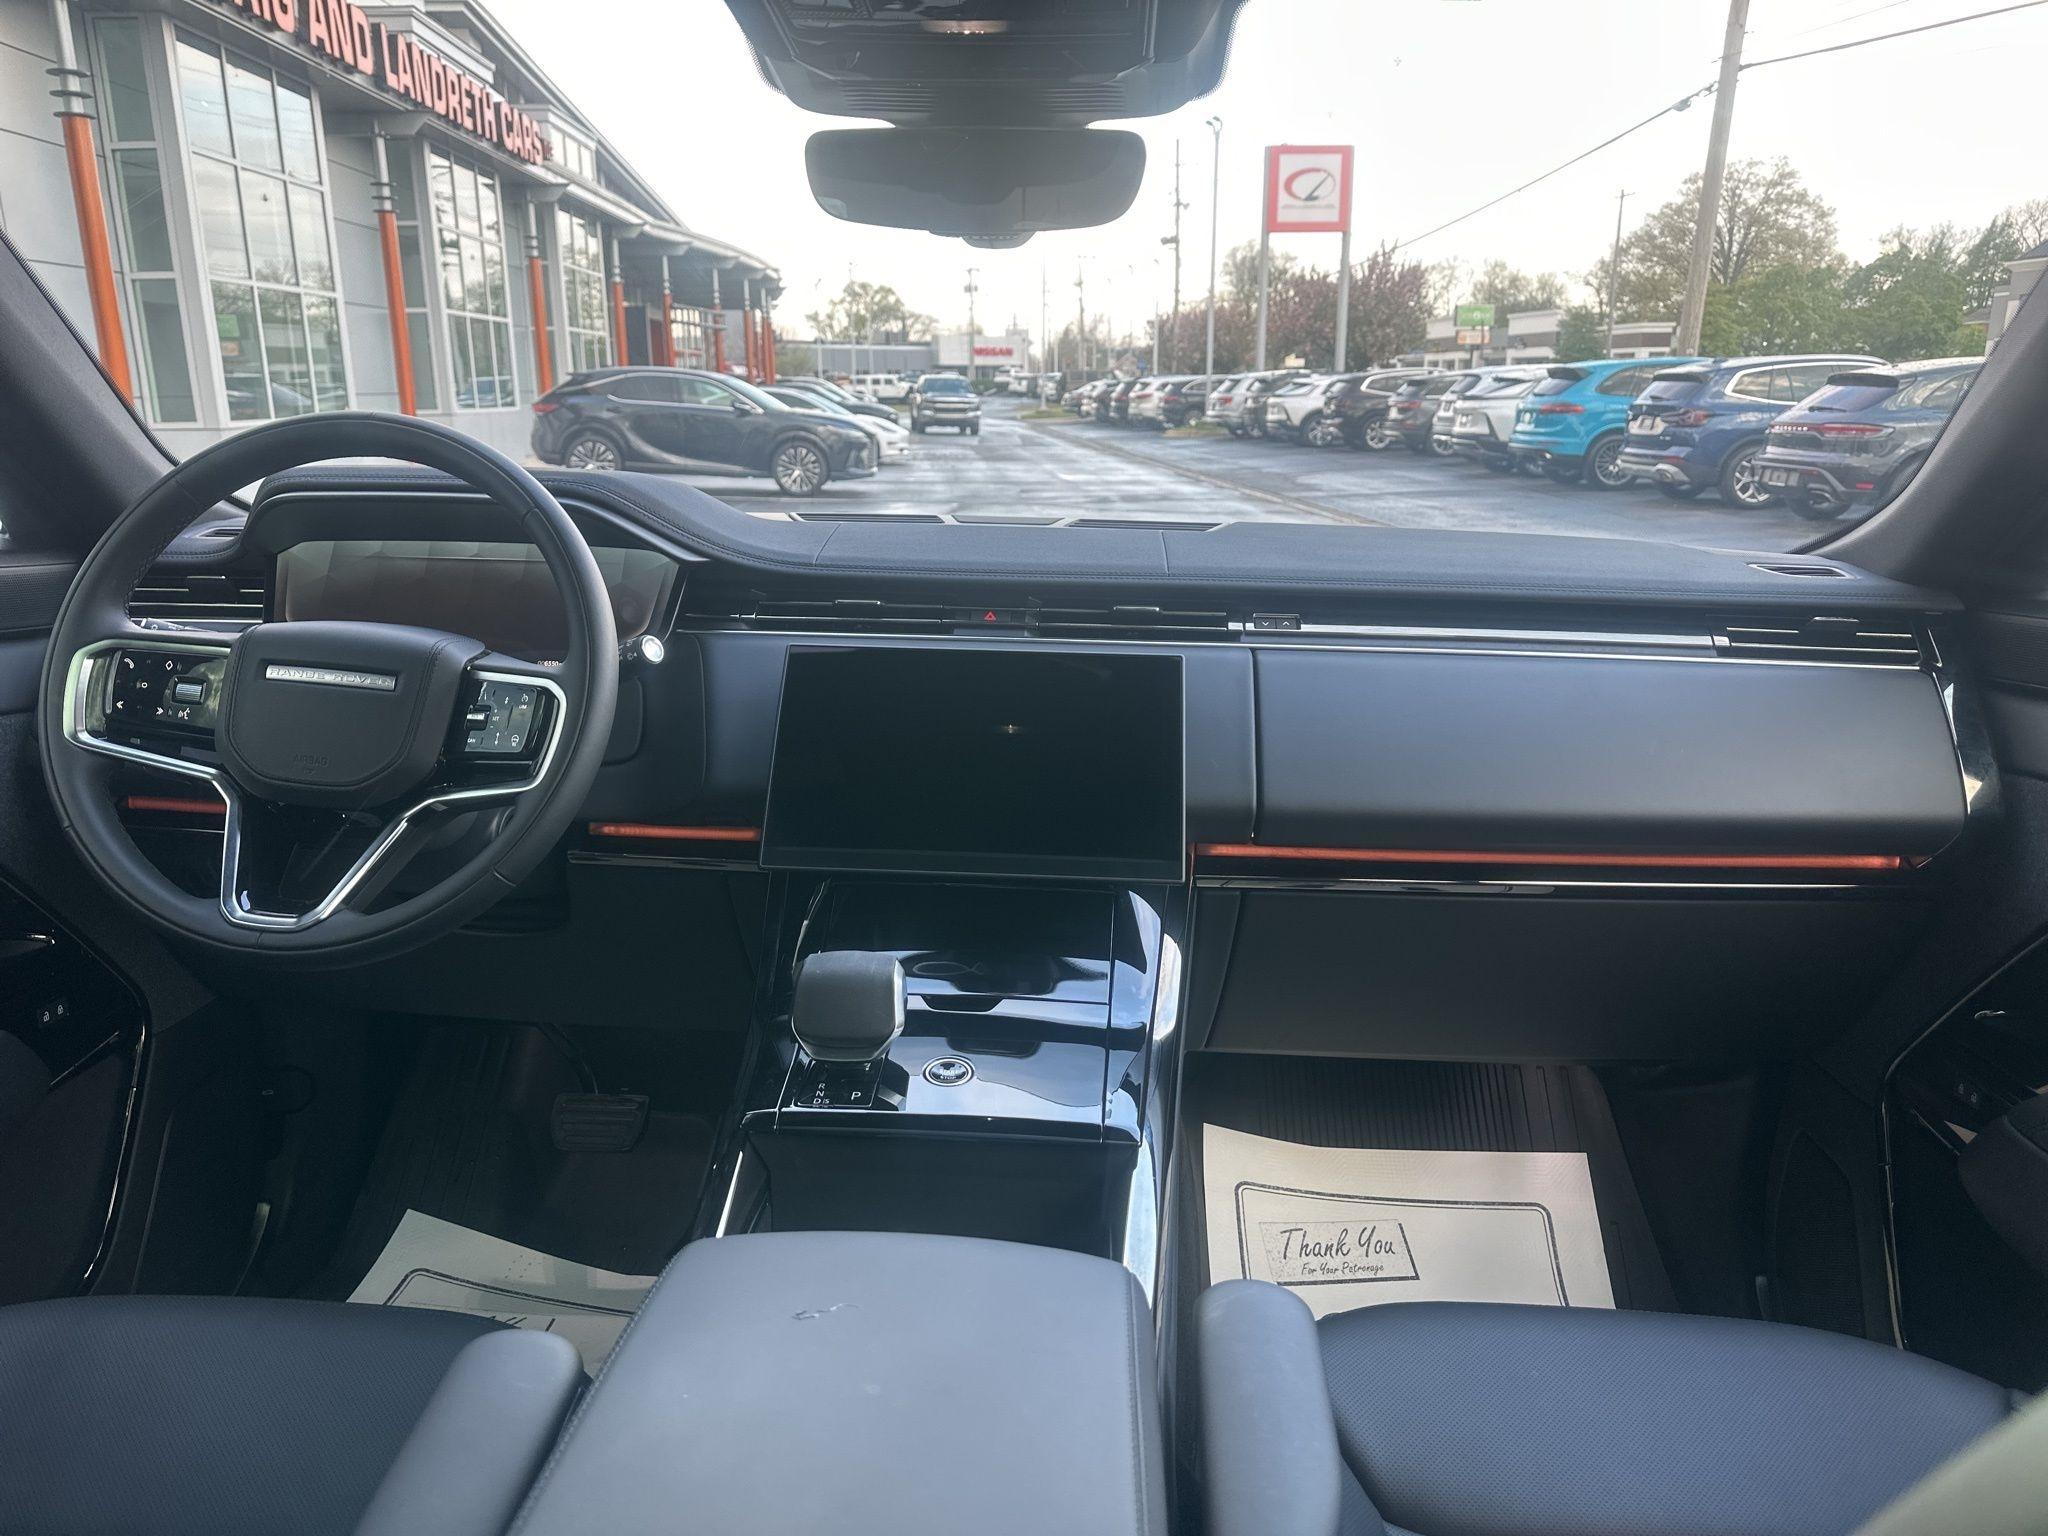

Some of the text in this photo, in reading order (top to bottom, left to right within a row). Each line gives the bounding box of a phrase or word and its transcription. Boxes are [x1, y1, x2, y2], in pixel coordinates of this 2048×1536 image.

[310, 0, 374, 75] AND
[380, 22, 498, 143] LANDRETH
[501, 101, 543, 165] CARS
[973, 346, 1013, 356] NISSAN
[269, 668, 392, 687] RANGE ROVER
[851, 1092, 861, 1100] P
[1279, 1226, 1396, 1260] Thank You
[1301, 1261, 1384, 1276] For Your Patronage
